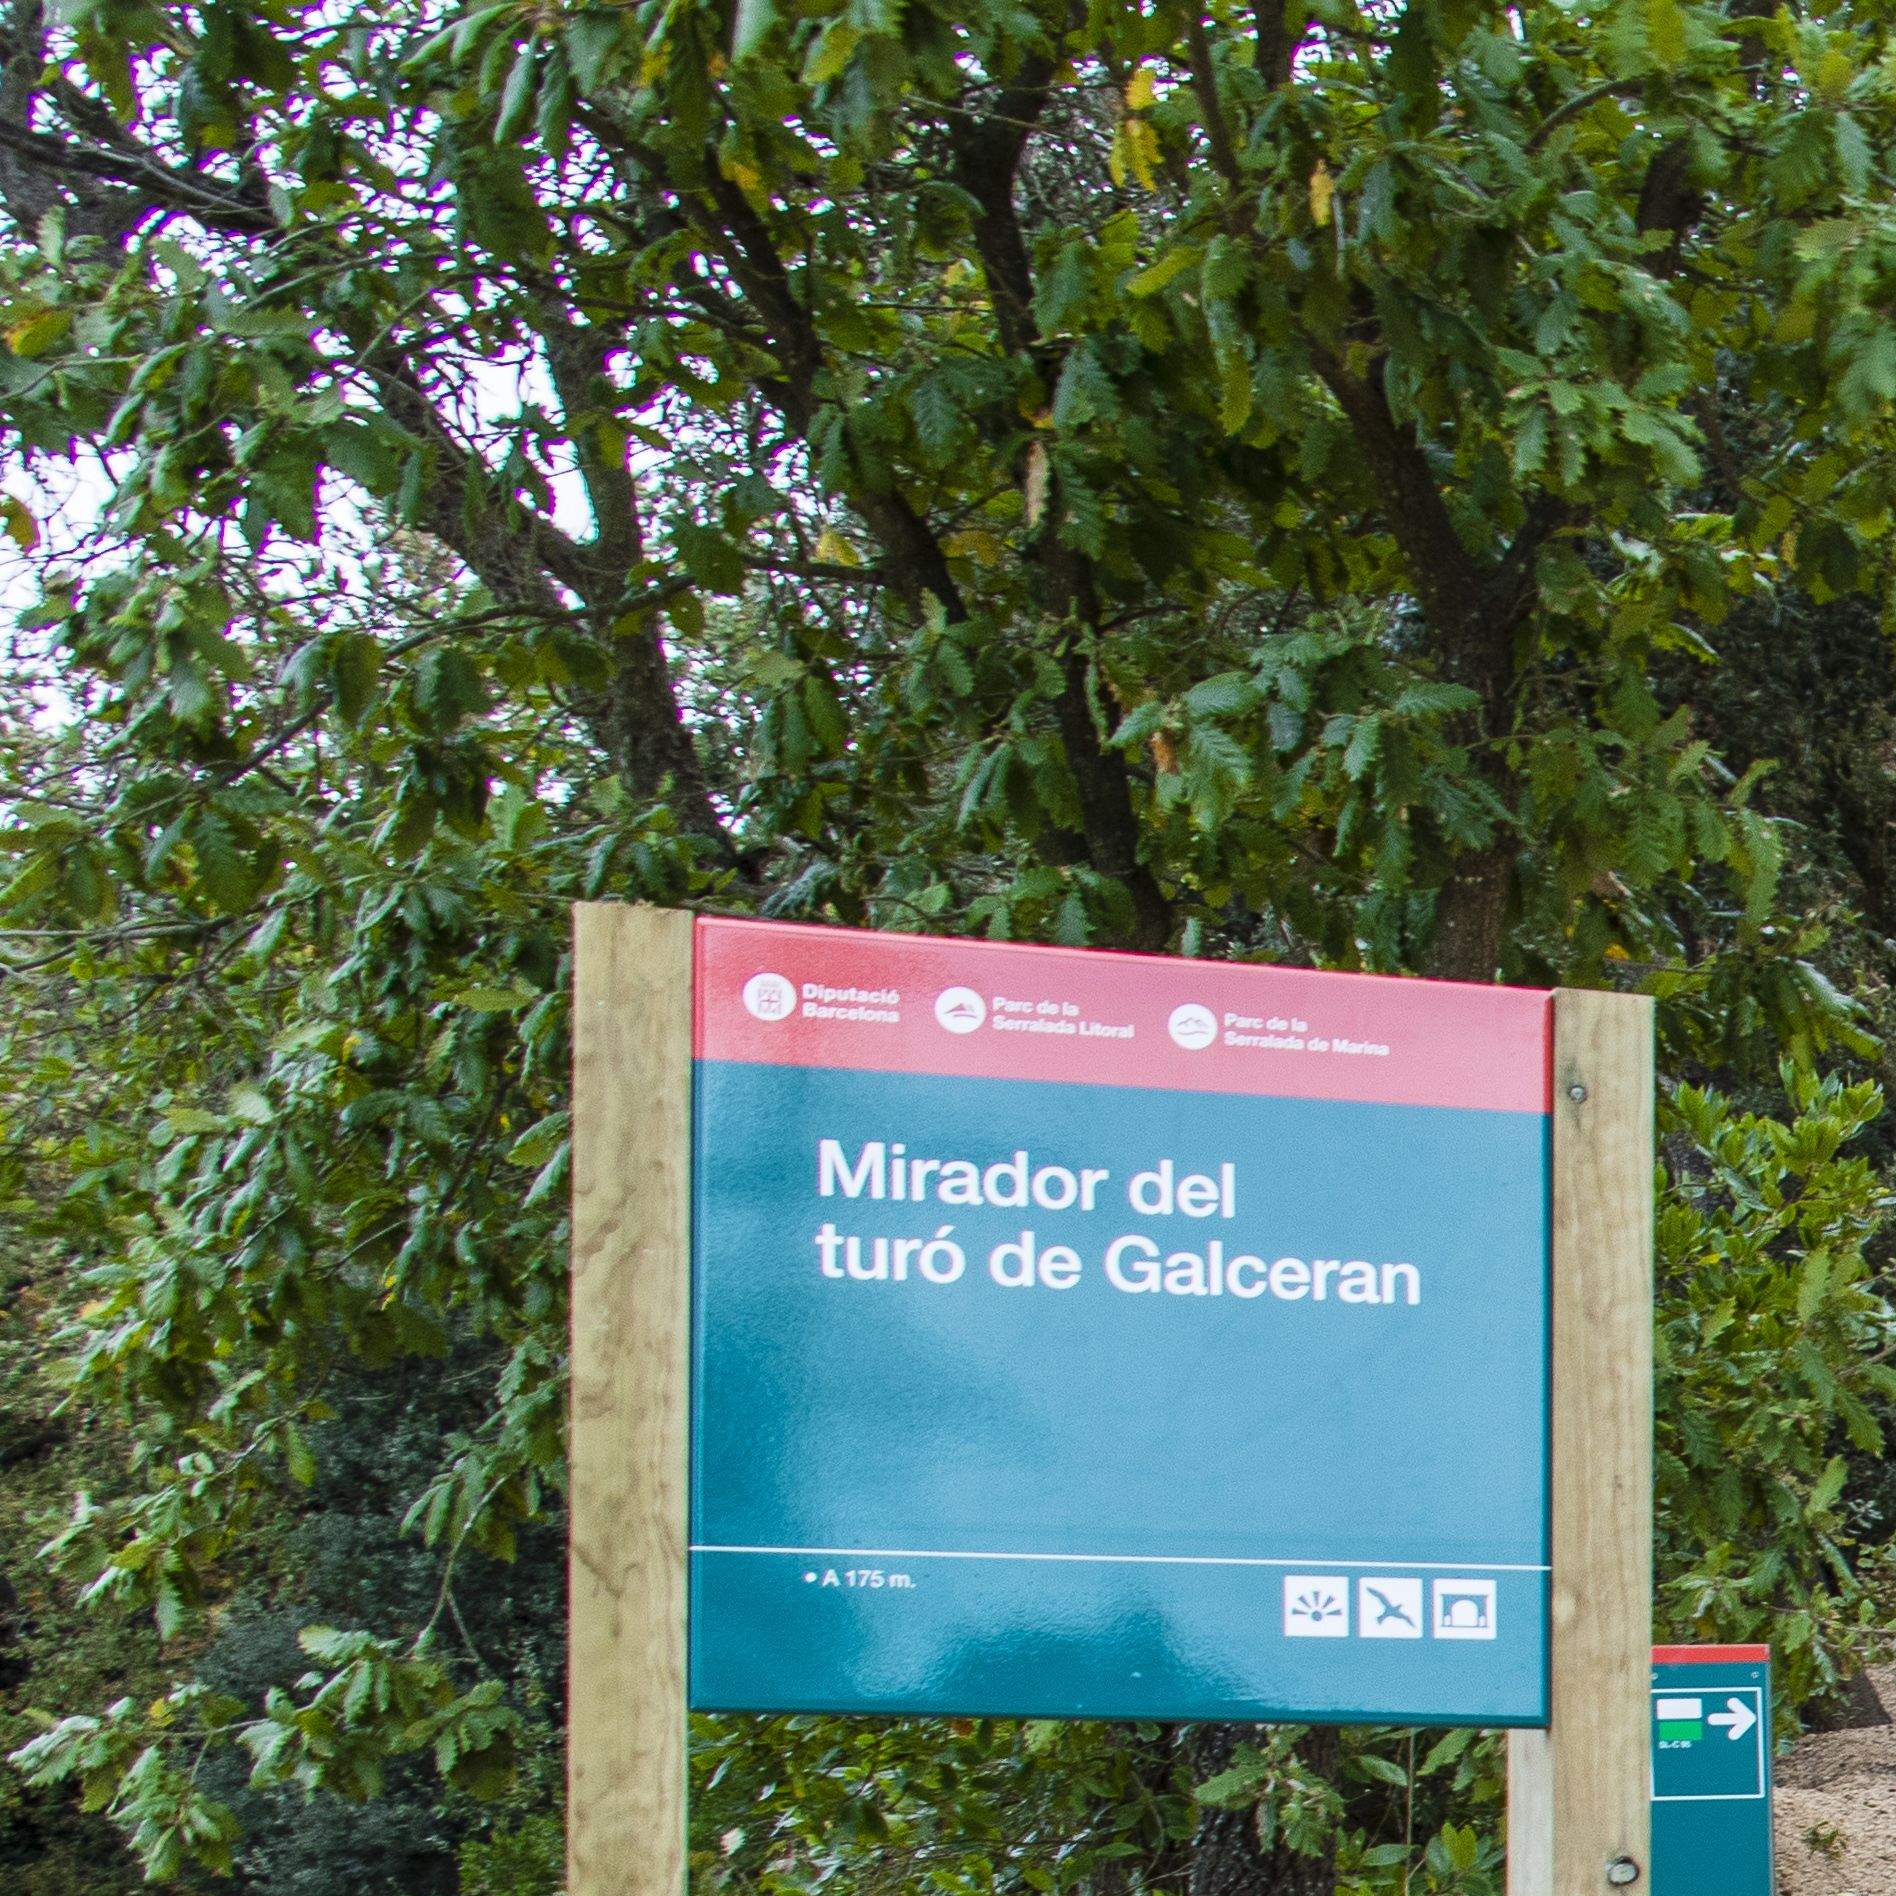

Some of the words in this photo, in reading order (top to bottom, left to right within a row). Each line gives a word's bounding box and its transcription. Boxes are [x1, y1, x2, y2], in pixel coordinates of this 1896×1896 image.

[802, 983, 901, 1005] Diputació
[802, 1002, 900, 1024] Barcelona
[992, 996, 1034, 1014] Parc
[1036, 1000, 1060, 1016] de
[1062, 1001, 1080, 1017] la
[992, 1014, 1077, 1036] Serralada
[1078, 1020, 1135, 1039] Litoral
[1224, 1012, 1263, 1029] Parc
[1266, 1016, 1289, 1031] de
[1291, 1017, 1308, 1033] la
[1224, 1030, 1305, 1050] Serralada
[1306, 1036, 1330, 1053] de
[1332, 1038, 1390, 1056] Marina
[818, 1138, 1108, 1214] Mirador
[1129, 1158, 1234, 1219] del
[814, 1222, 966, 1285] turó
[989, 1229, 1081, 1289] de
[1105, 1233, 1421, 1305] Galceran
[822, 1568, 841, 1587] A
[844, 1569, 886, 1589] 175
[886, 1573, 918, 1589] m.
